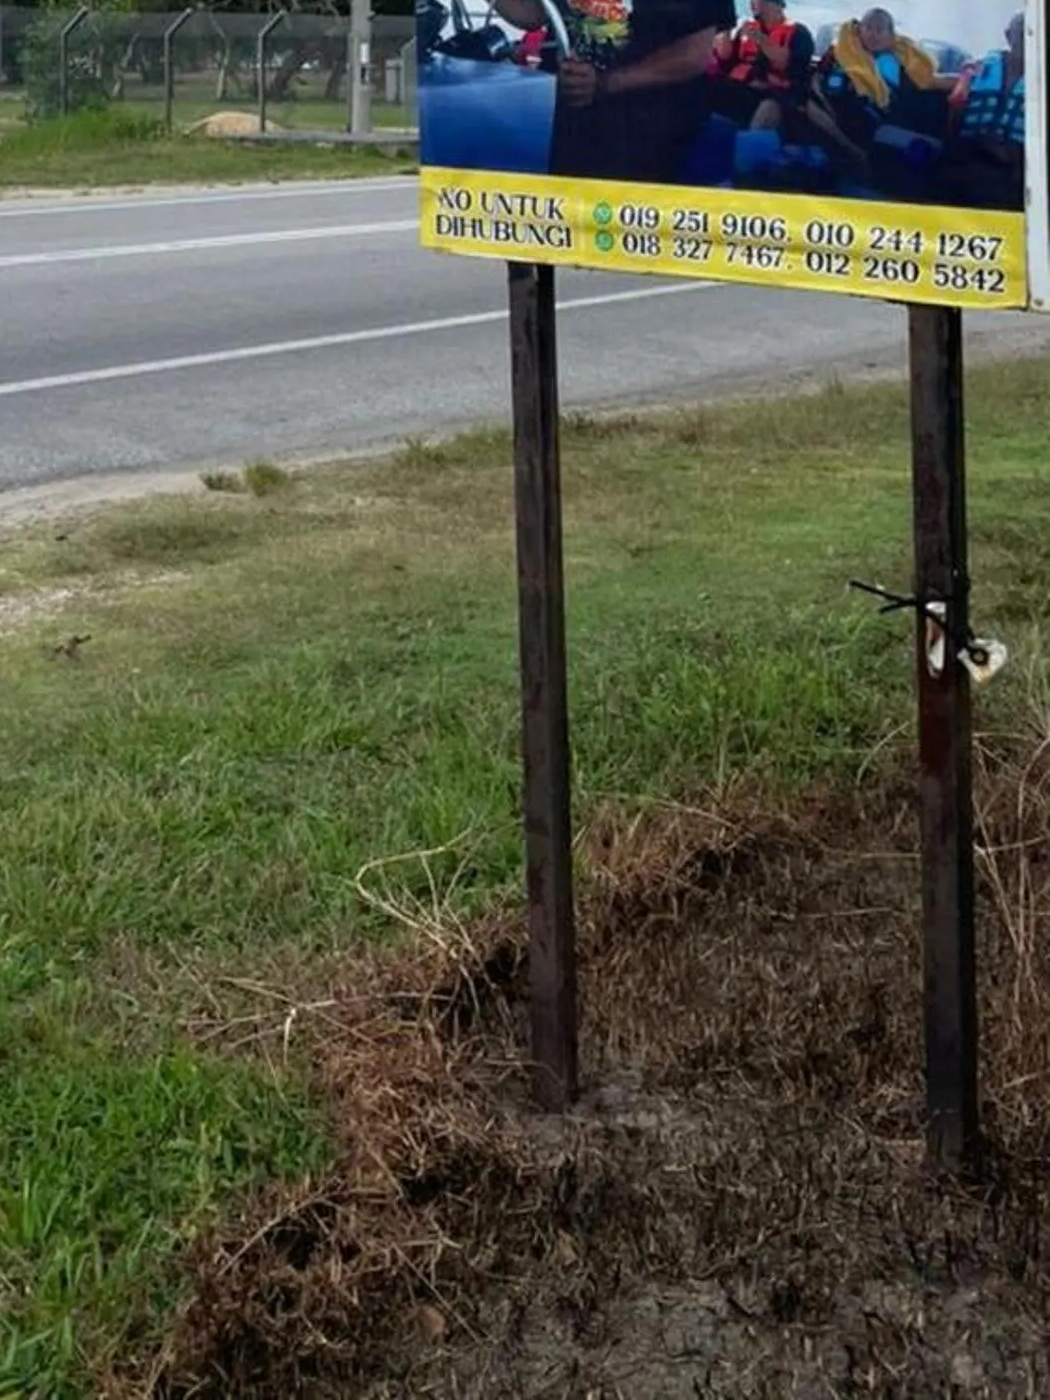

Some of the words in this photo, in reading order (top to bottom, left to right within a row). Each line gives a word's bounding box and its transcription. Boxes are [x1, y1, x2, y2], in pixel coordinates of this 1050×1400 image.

[438, 187, 472, 211] NO
[481, 191, 565, 220] UNTUK
[435, 214, 572, 248] DIHUBUNGI
[619, 204, 660, 228] 019
[673, 210, 709, 233] 251
[806, 220, 854, 246] 010
[869, 226, 922, 253] 244
[938, 232, 1003, 261] 1267
[622, 231, 661, 256] 018
[673, 237, 712, 261] 327
[806, 252, 850, 275] 012
[863, 256, 919, 283] 260
[934, 263, 1005, 293] 5842
